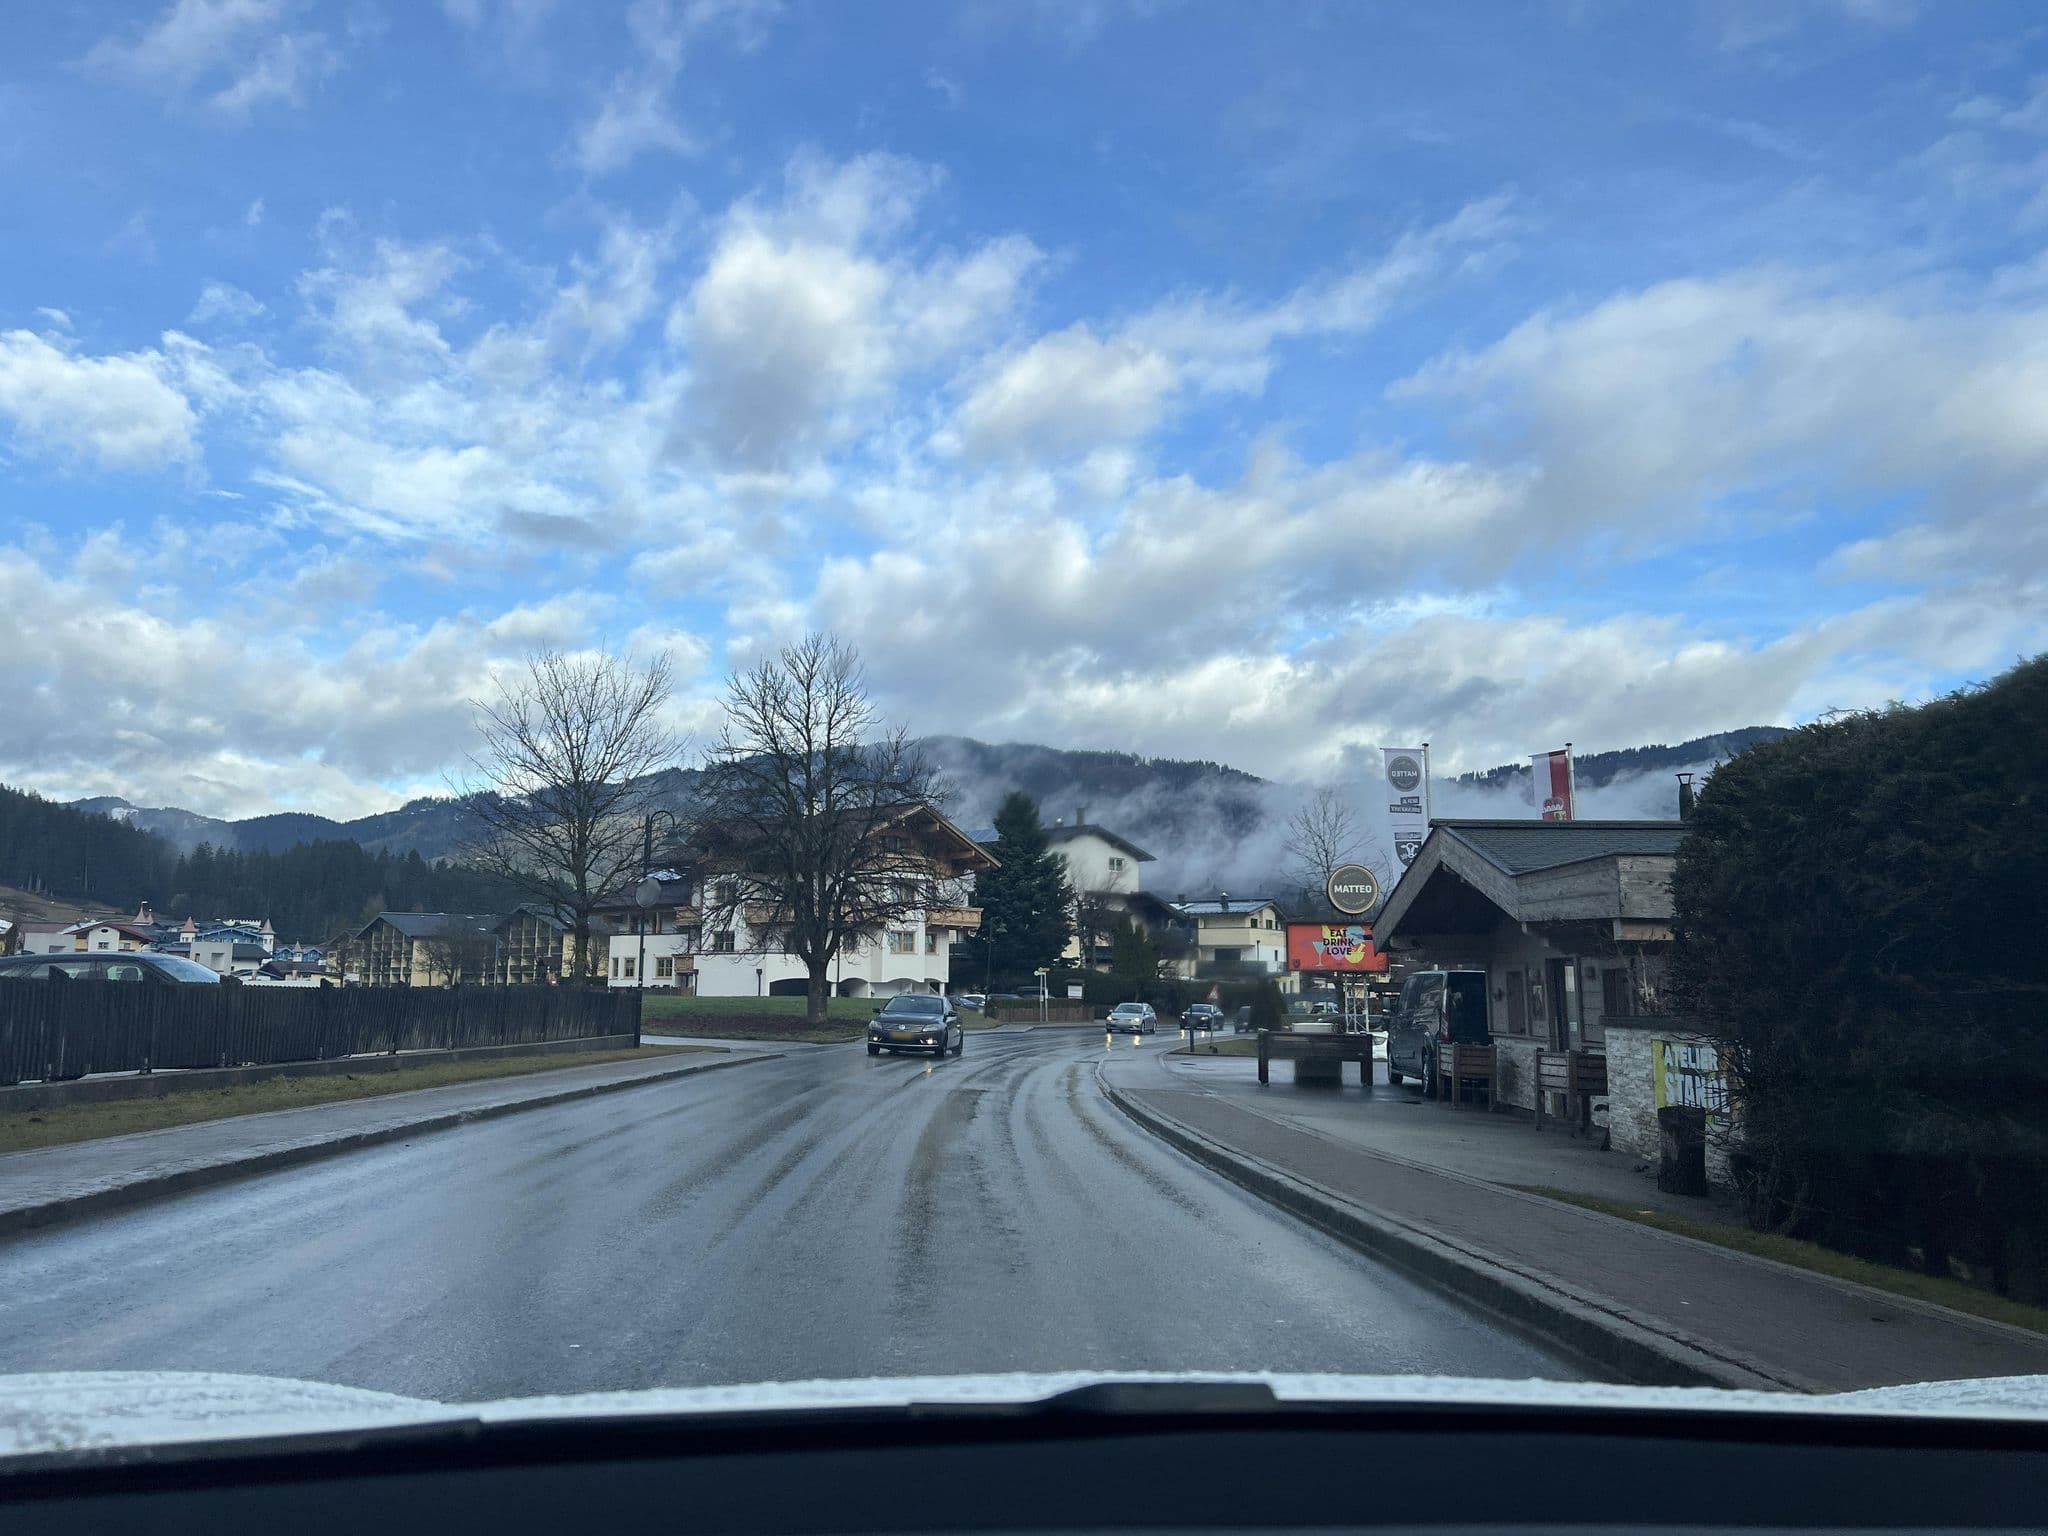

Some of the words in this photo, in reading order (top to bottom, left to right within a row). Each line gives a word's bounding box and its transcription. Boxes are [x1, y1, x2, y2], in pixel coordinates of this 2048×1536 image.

[1333, 884, 1372, 894] MATTEO
[1330, 929, 1347, 937] EAT
[1323, 938, 1354, 946] DRINK
[1327, 947, 1352, 955] LOVE
